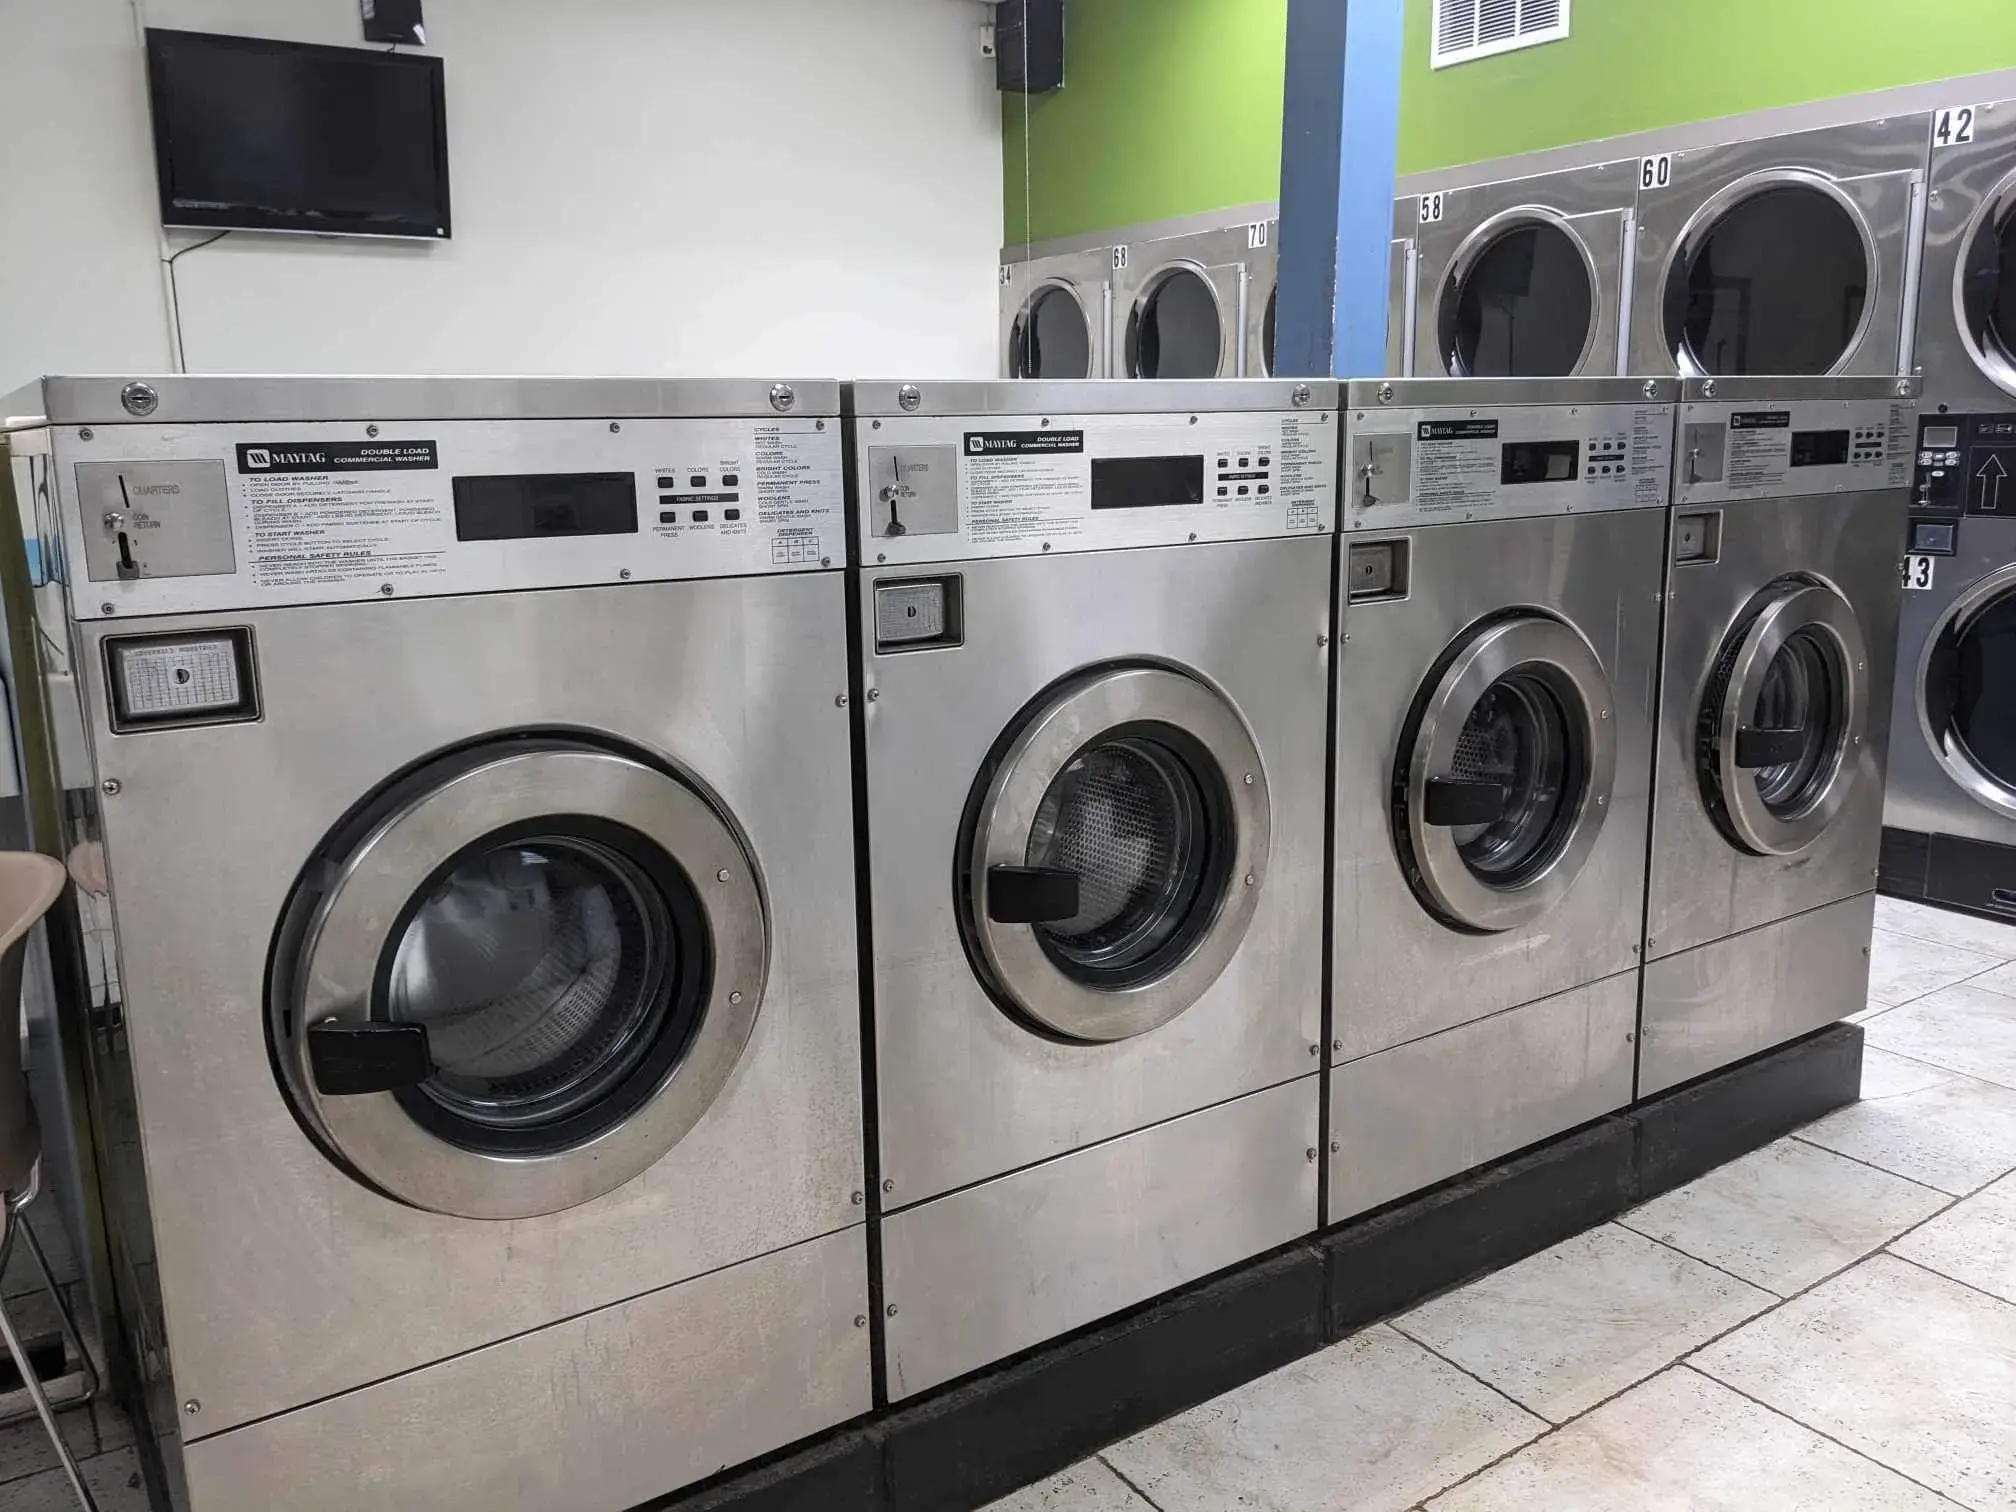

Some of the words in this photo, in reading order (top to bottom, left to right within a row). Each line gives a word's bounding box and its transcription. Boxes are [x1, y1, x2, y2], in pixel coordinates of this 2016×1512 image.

[1936, 108, 1972, 144] 42
[1642, 156, 1668, 187] 60
[1421, 195, 1441, 221] 58
[1250, 223, 1265, 247] 70
[1114, 247, 1126, 267] 68
[985, 440, 1016, 448] MAYTAG
[272, 452, 325, 463] MAYTAG
[132, 485, 180, 495] QUARTERS
